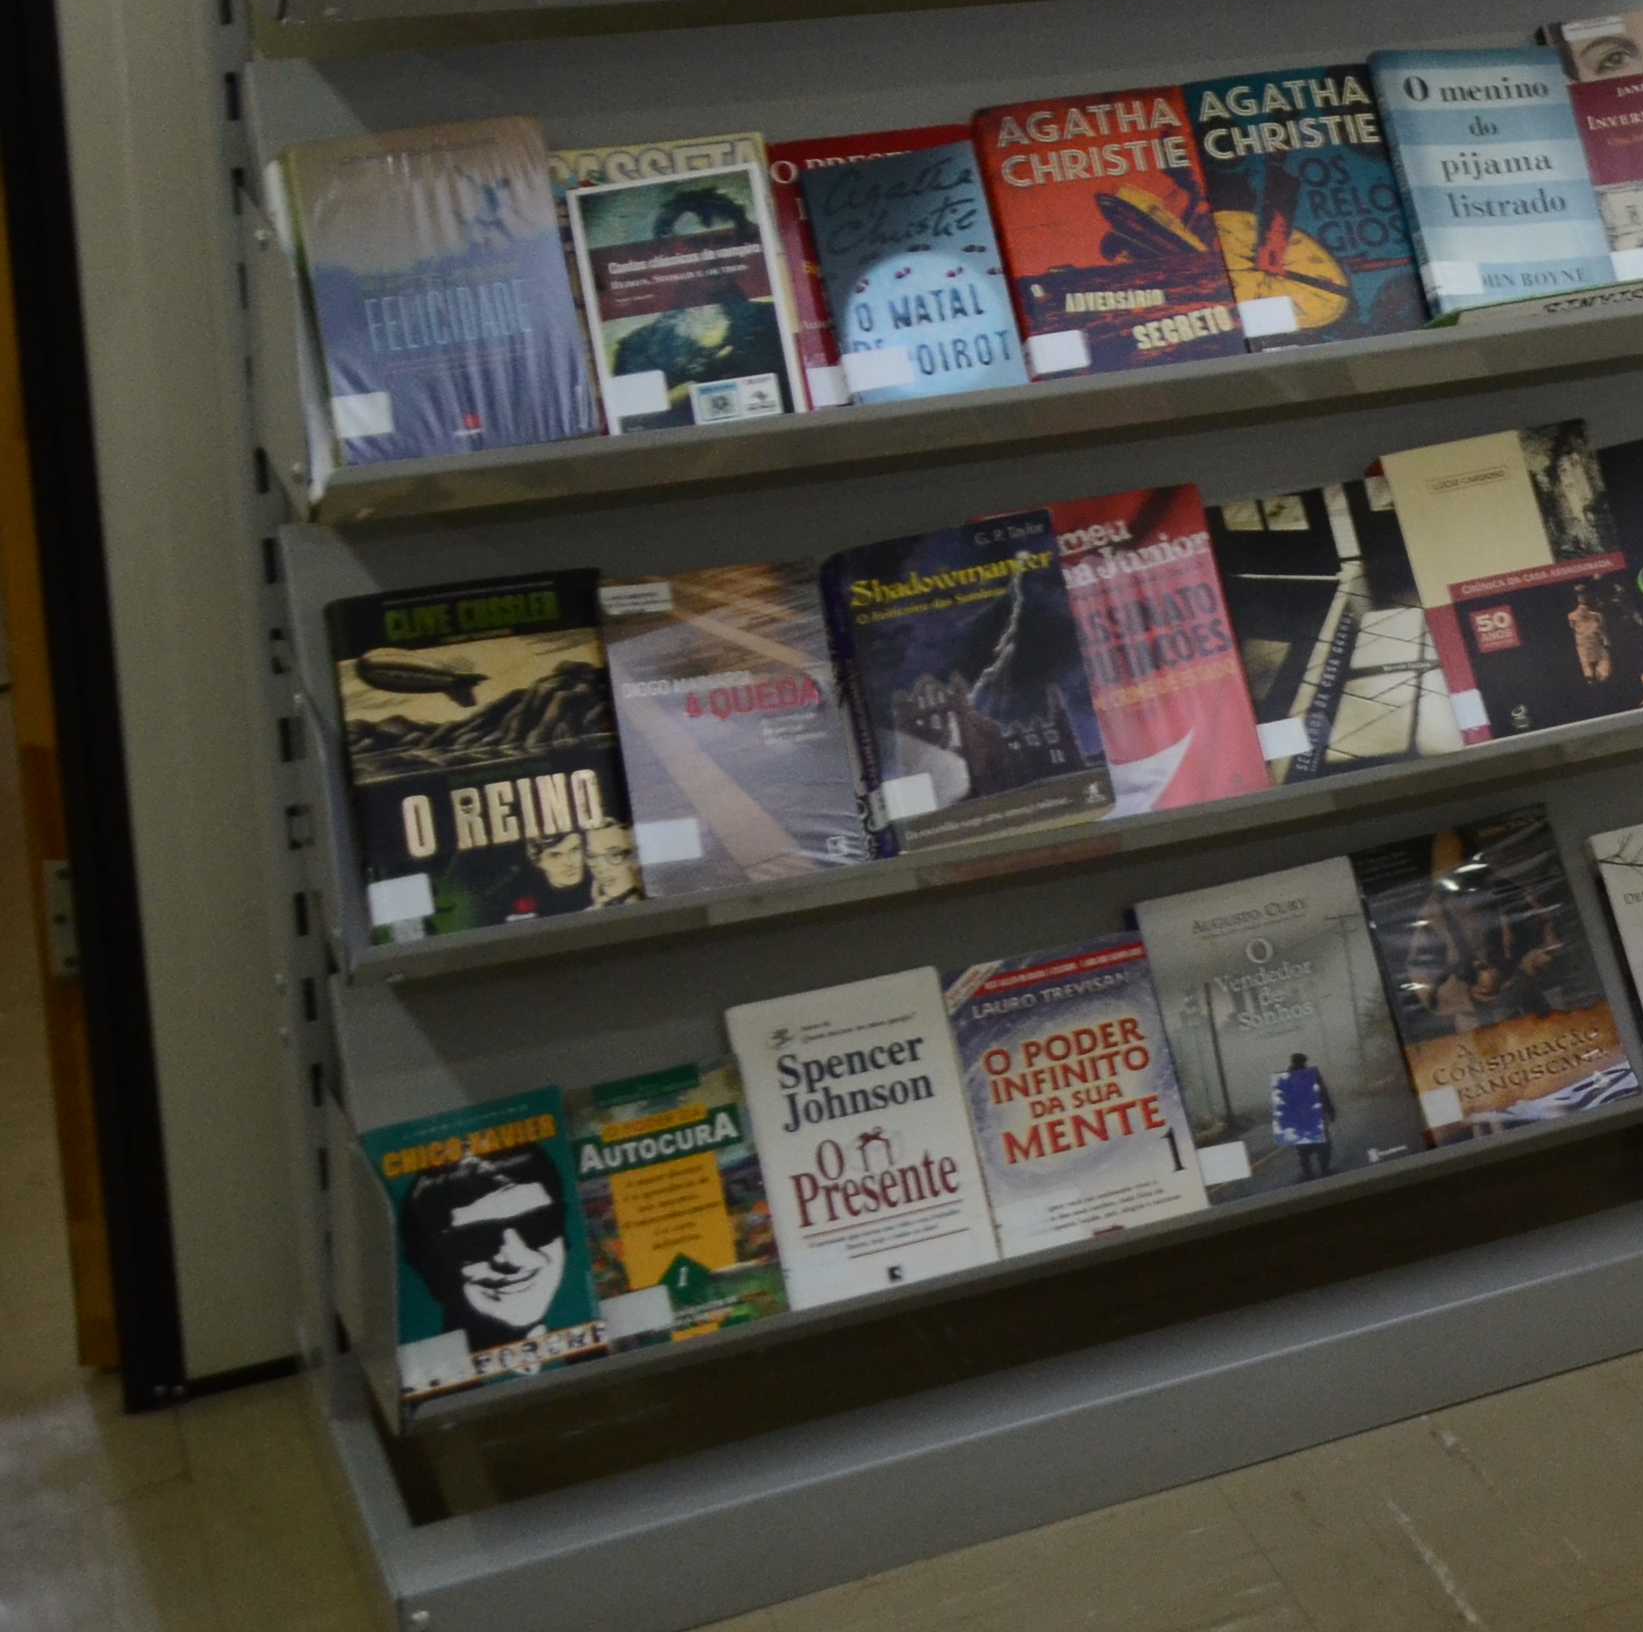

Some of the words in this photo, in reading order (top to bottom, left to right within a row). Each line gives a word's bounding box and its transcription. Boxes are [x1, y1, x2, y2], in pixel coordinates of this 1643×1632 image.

[1199, 75, 1372, 122] AGATHA
[1439, 77, 1549, 104] menino
[998, 97, 1182, 148] AGATHA
[1203, 113, 1382, 160] CHRISTIE
[1469, 115, 1498, 138] do
[1001, 135, 1193, 188] CHRISTIE
[1440, 151, 1552, 183] pijama
[826, 198, 977, 255] Christie
[1448, 188, 1568, 219] listrado
[888, 284, 985, 330] NATAL
[1132, 304, 1234, 352] SECRETO
[850, 551, 1053, 608] Shadowmancer
[1461, 578, 1505, 595] CRÔNICA
[1550, 558, 1612, 580] ASSASSINADA
[1474, 610, 1512, 633] 50
[1481, 629, 1513, 644] ANOS
[622, 679, 668, 699] DIOGO
[708, 675, 823, 721] QUEDA
[402, 794, 437, 859] O
[450, 768, 603, 850] REINO
[775, 1035, 925, 1095] Spencer
[982, 1048, 1012, 1077] O
[1021, 1017, 1146, 1067] PODER
[989, 1045, 1150, 1105] INFINITO
[783, 1074, 935, 1133] Johnson
[1029, 1092, 1066, 1119] DA
[1072, 1081, 1123, 1109] SUA
[580, 1109, 740, 1174] AUTOCURA
[1002, 1095, 1166, 1165] MENTE
[816, 1139, 845, 1180] O
[790, 1148, 959, 1229] Presente
